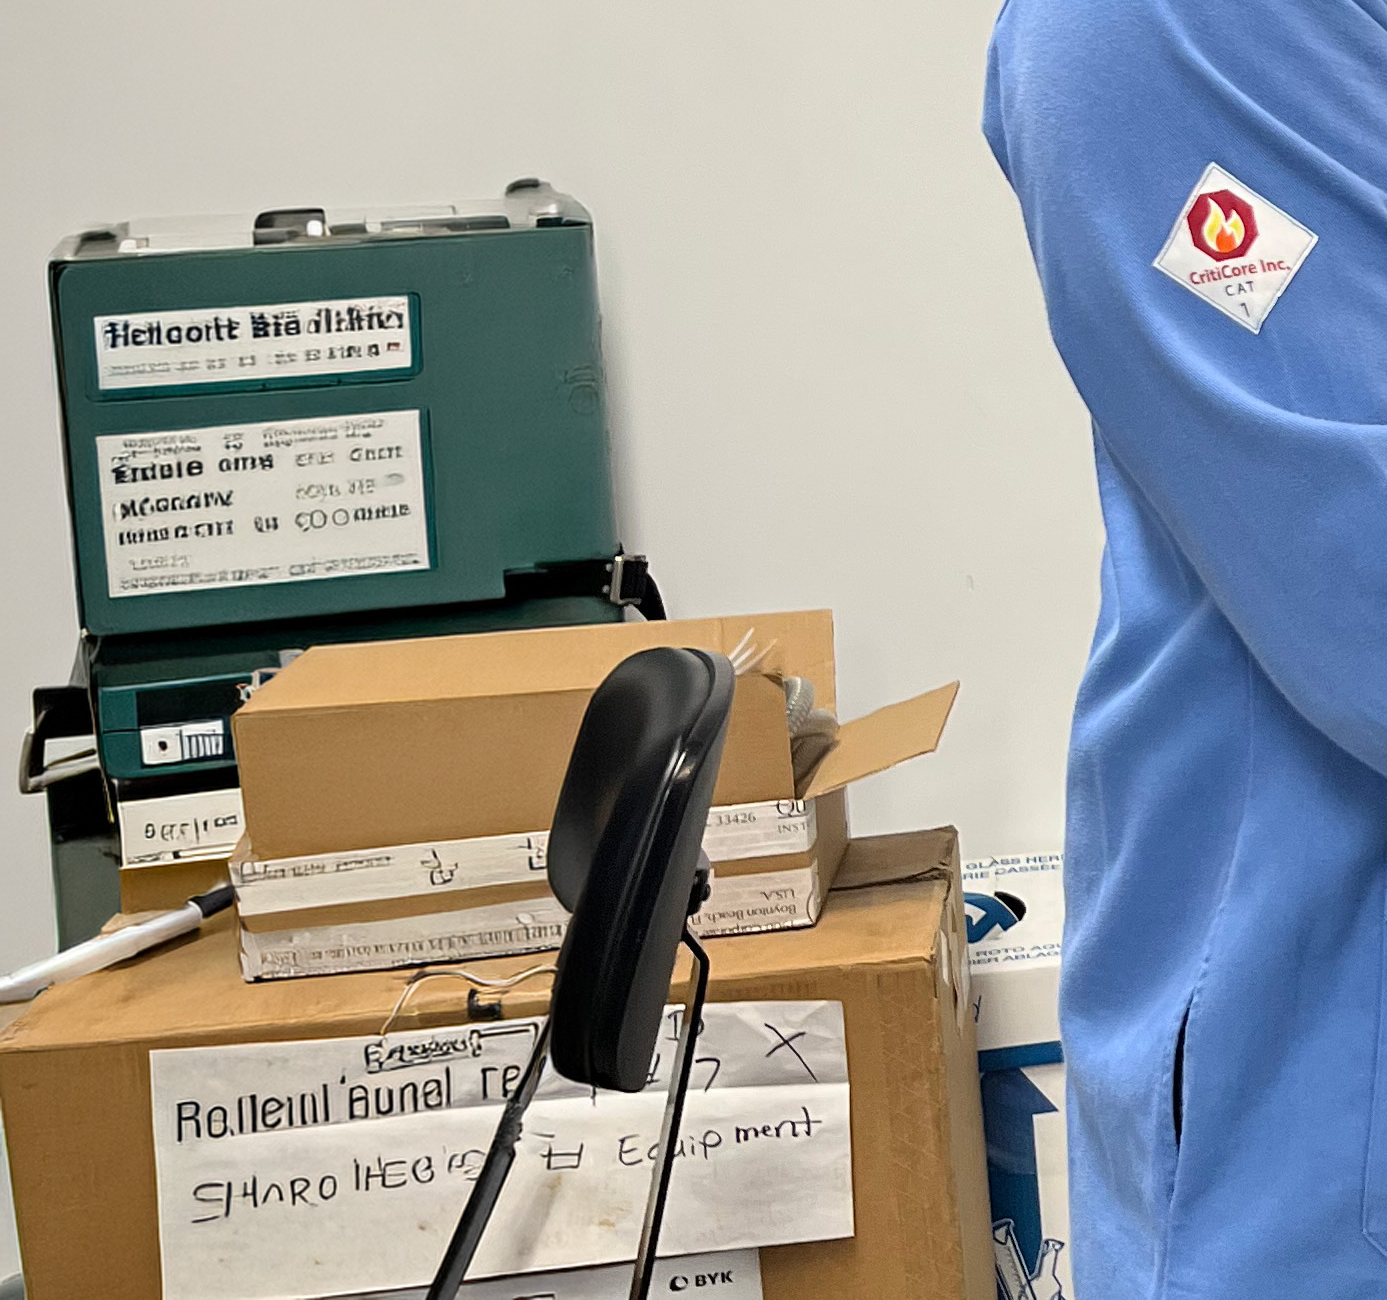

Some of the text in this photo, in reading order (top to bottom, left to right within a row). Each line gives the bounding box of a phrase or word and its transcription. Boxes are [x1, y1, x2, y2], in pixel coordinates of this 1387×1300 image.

[1190, 259, 1291, 286] CritiCore Inc.
[716, 812, 757, 827] 33426
[746, 903, 797, 919] Boynton
[695, 1270, 734, 1288] BYK
